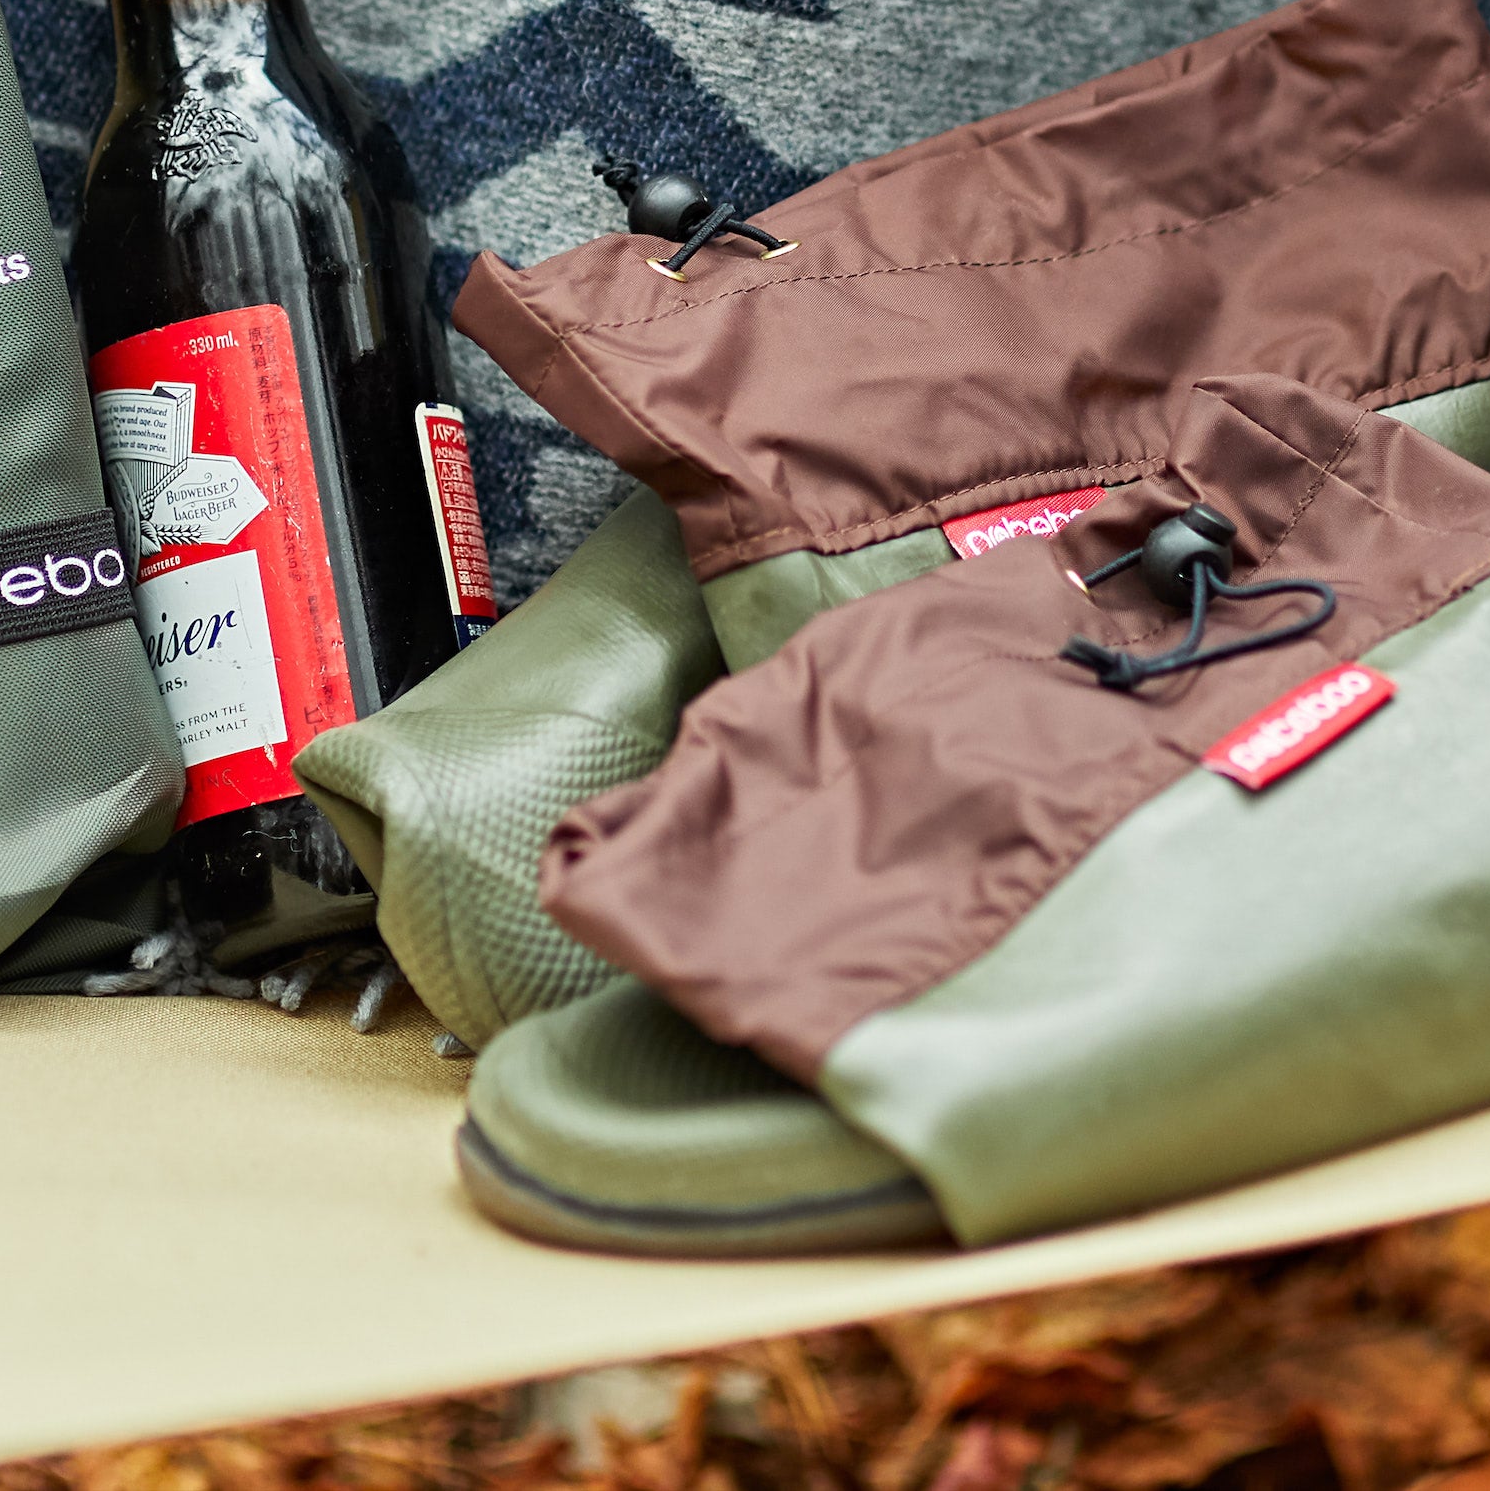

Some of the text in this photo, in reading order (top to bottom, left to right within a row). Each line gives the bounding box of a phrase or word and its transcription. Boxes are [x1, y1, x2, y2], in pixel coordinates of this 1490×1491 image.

[189, 335, 214, 356] 330
[137, 406, 168, 417] produced
[154, 419, 168, 429] Our
[129, 429, 167, 440] smoothness
[149, 443, 168, 453] price.
[188, 711, 218, 726] FROM
[221, 703, 246, 716] THE
[215, 719, 248, 733] MALT
